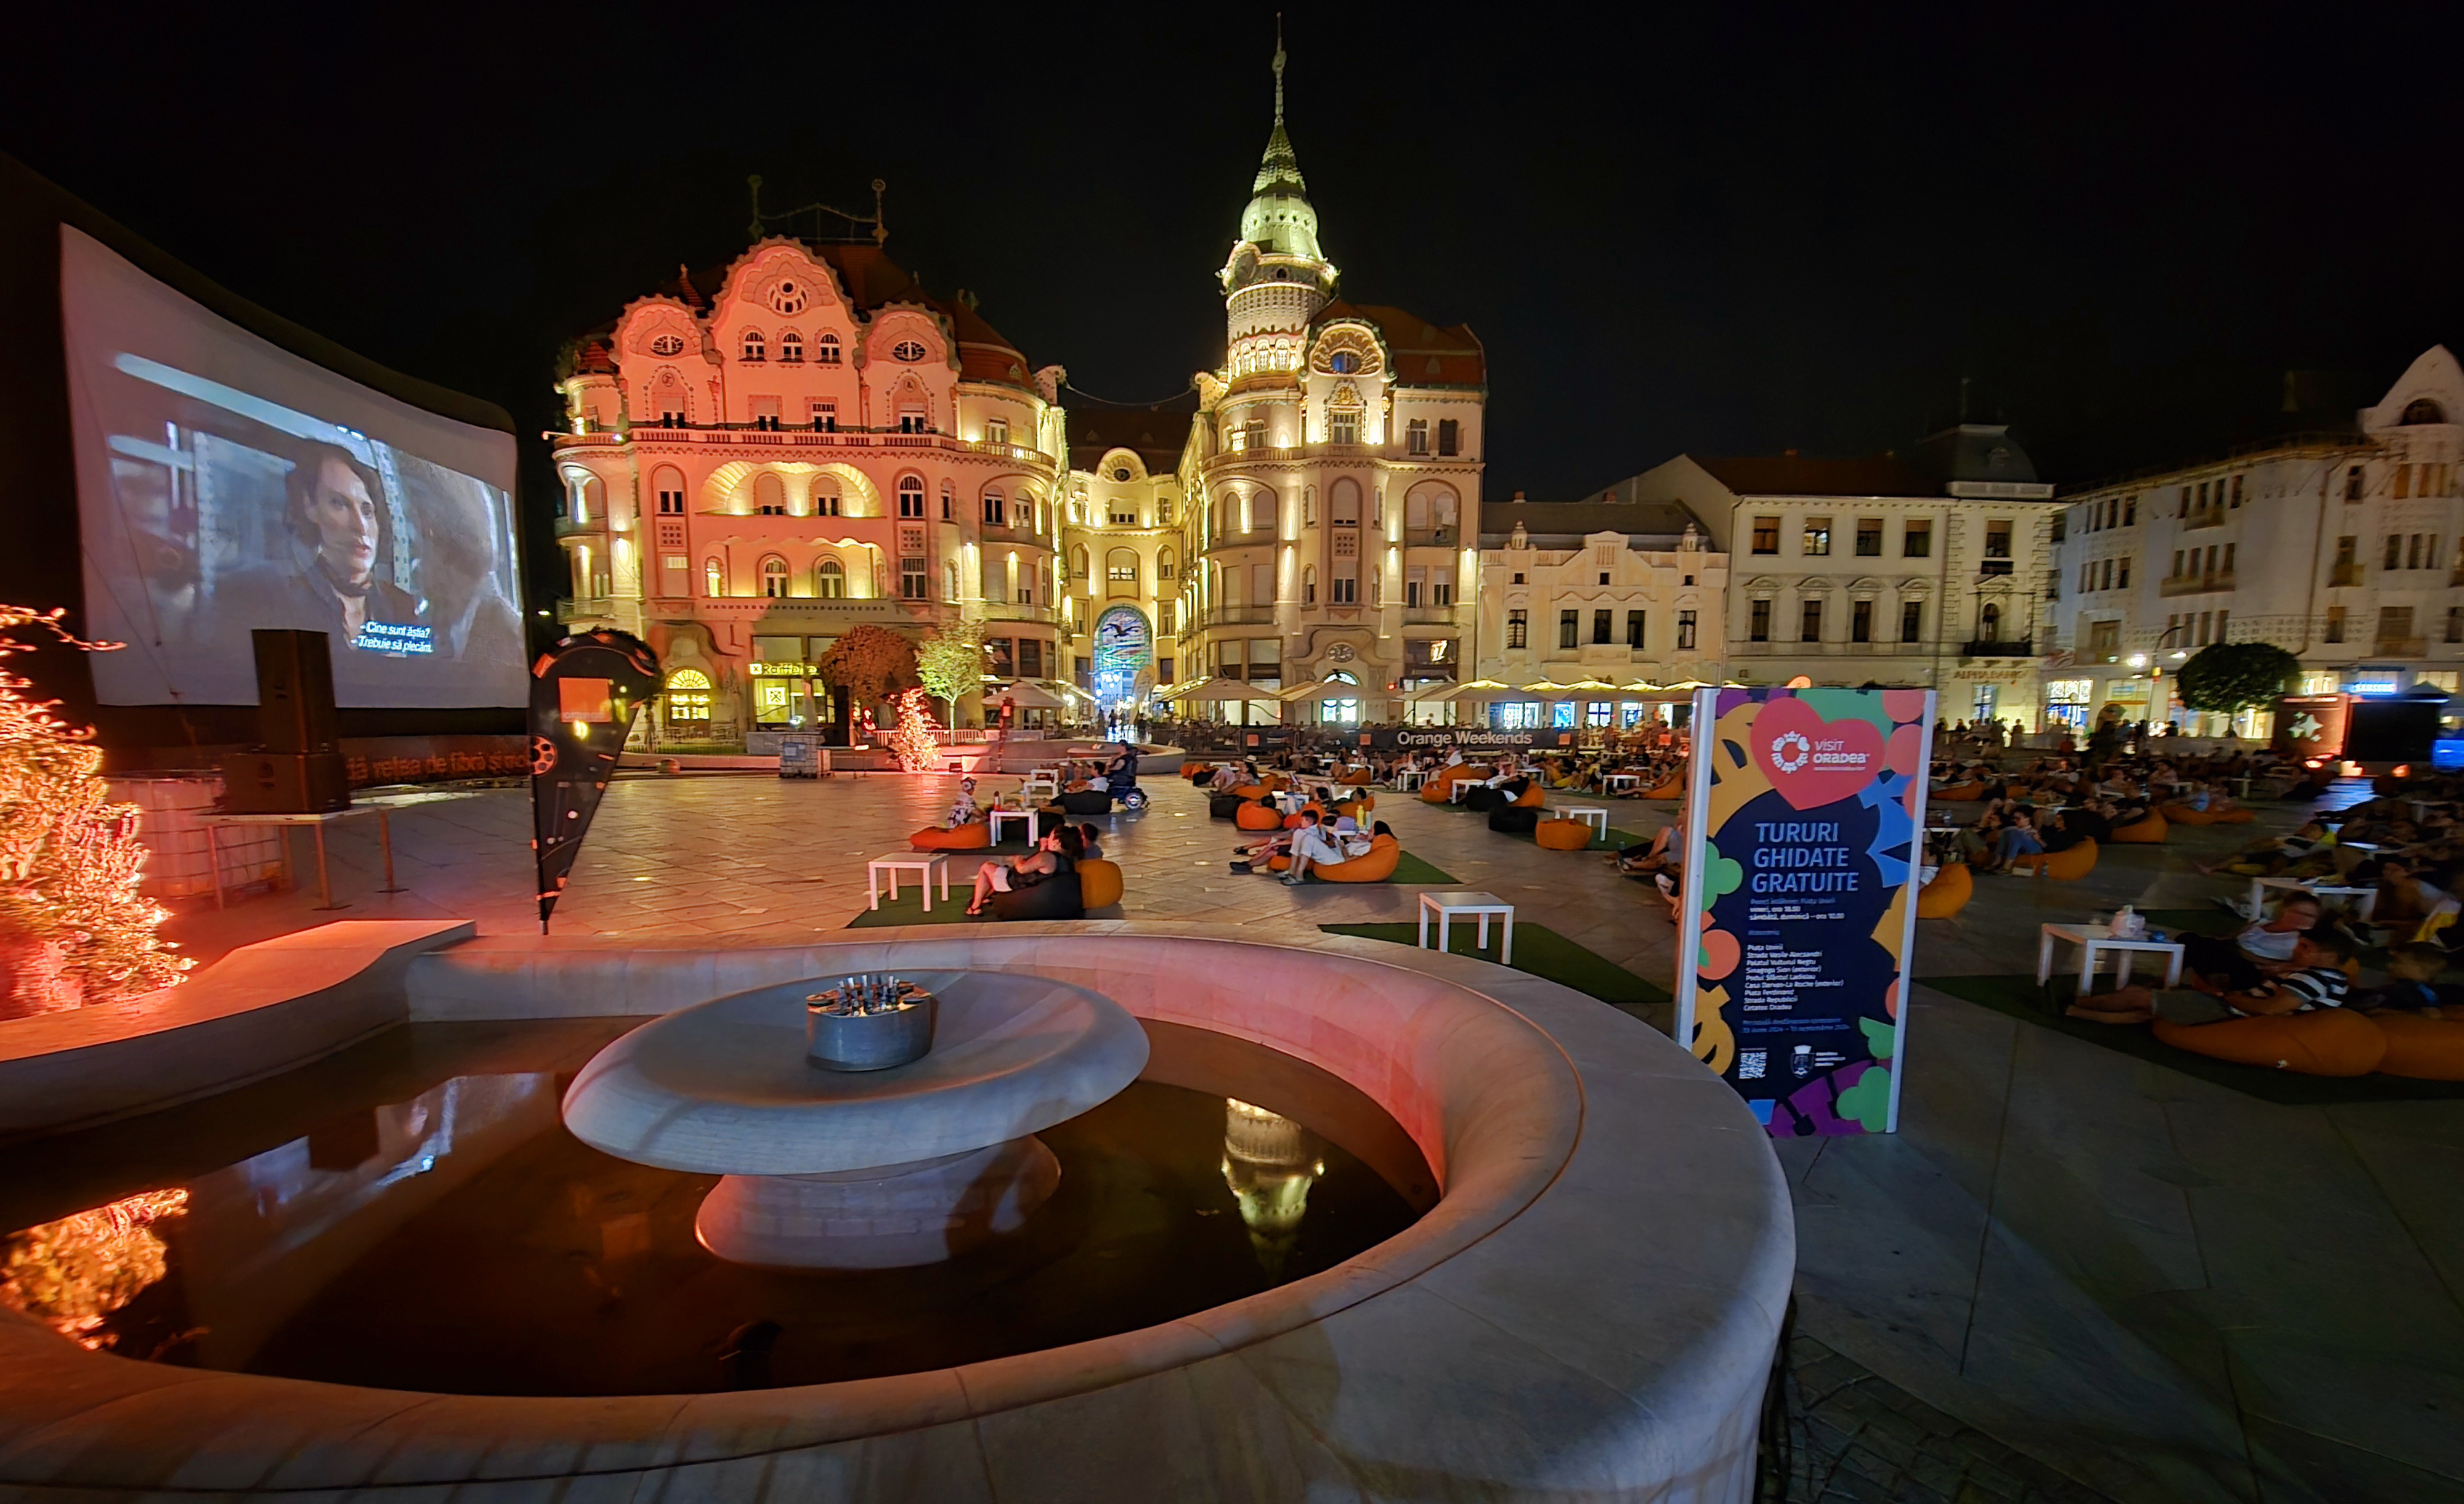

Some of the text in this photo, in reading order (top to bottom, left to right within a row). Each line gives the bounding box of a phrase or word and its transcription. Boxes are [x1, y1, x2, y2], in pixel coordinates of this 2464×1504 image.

[366, 621, 387, 634] Cine
[387, 626, 406, 636] sunt
[358, 636, 391, 649] Trebuie
[391, 639, 402, 650] să
[1397, 730, 1533, 746] Orange Weekends
[1754, 822, 1839, 843] TURURI
[1754, 847, 1850, 868] GHIDATE
[1752, 872, 1859, 892] GRATUITE
